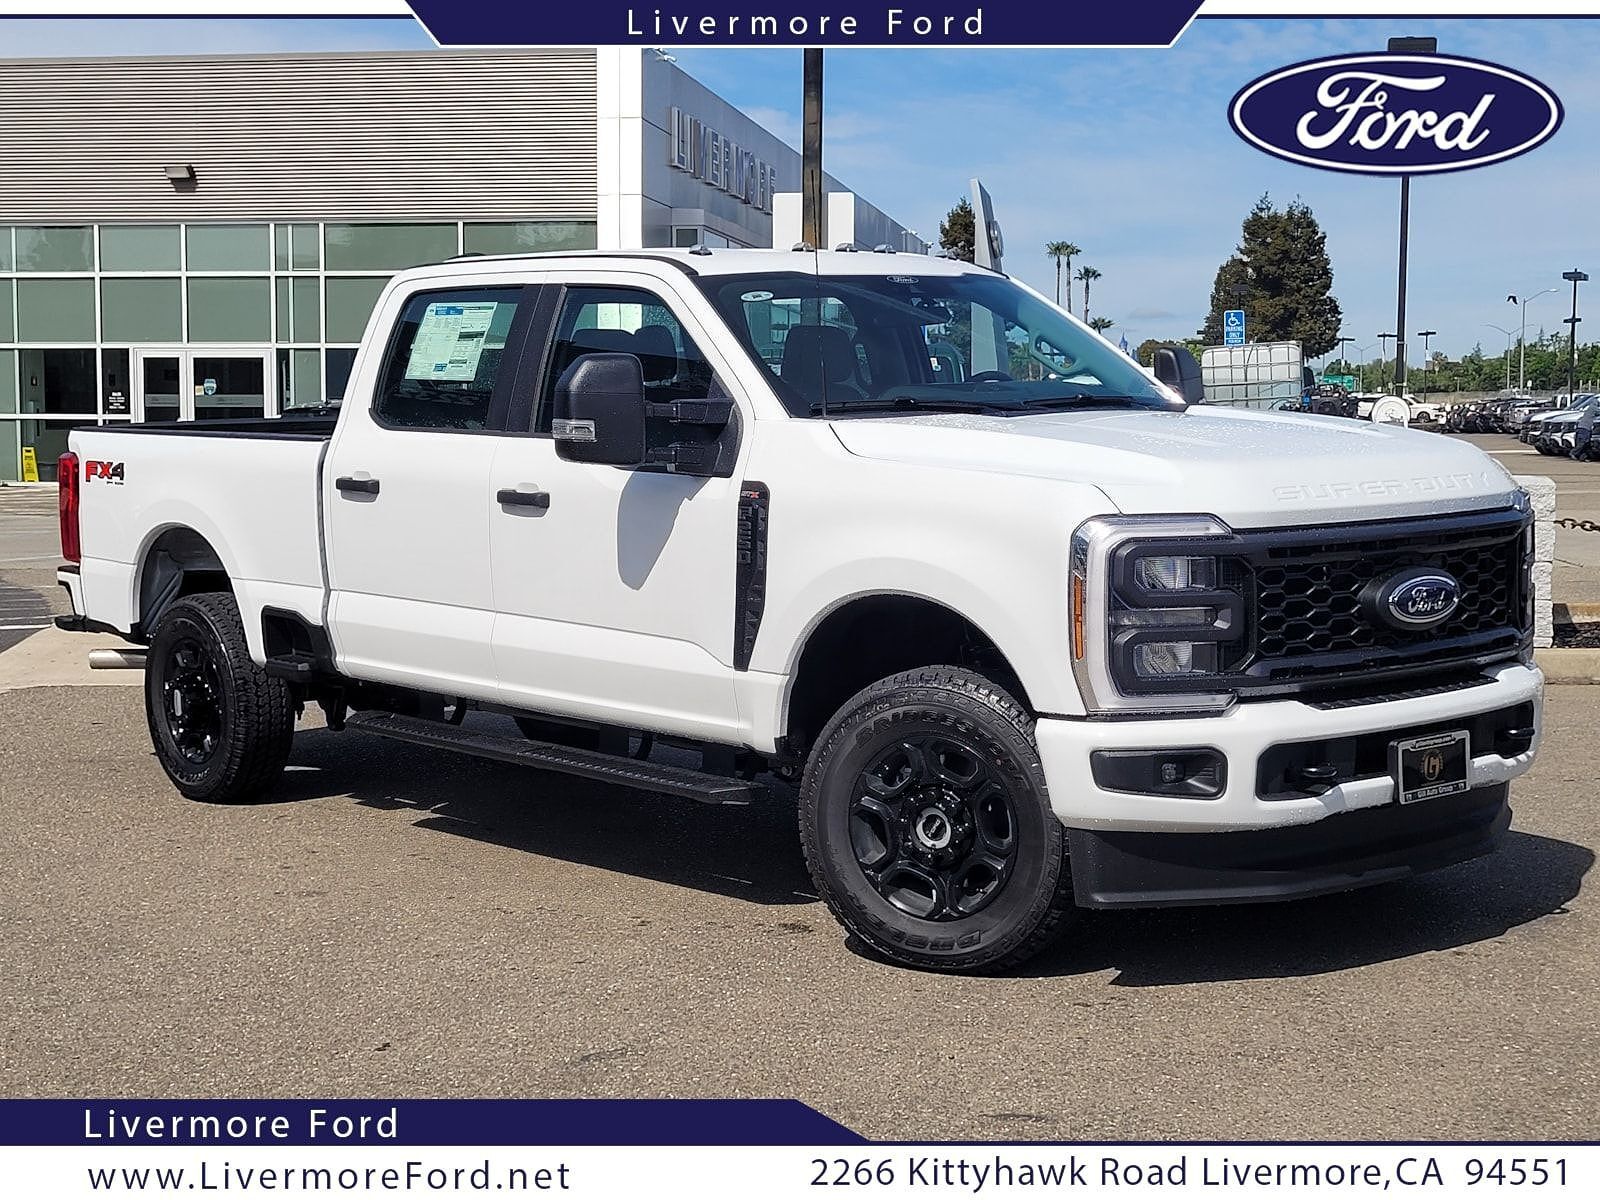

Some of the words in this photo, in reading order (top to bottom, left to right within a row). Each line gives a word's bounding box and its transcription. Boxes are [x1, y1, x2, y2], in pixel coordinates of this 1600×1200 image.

[670, 106, 777, 215] LIVERMORE
[86, 460, 125, 482] FX4
[1272, 479, 1405, 502] SUPER
[1411, 470, 1491, 492] DUTY
[1407, 586, 1446, 614] Ford
